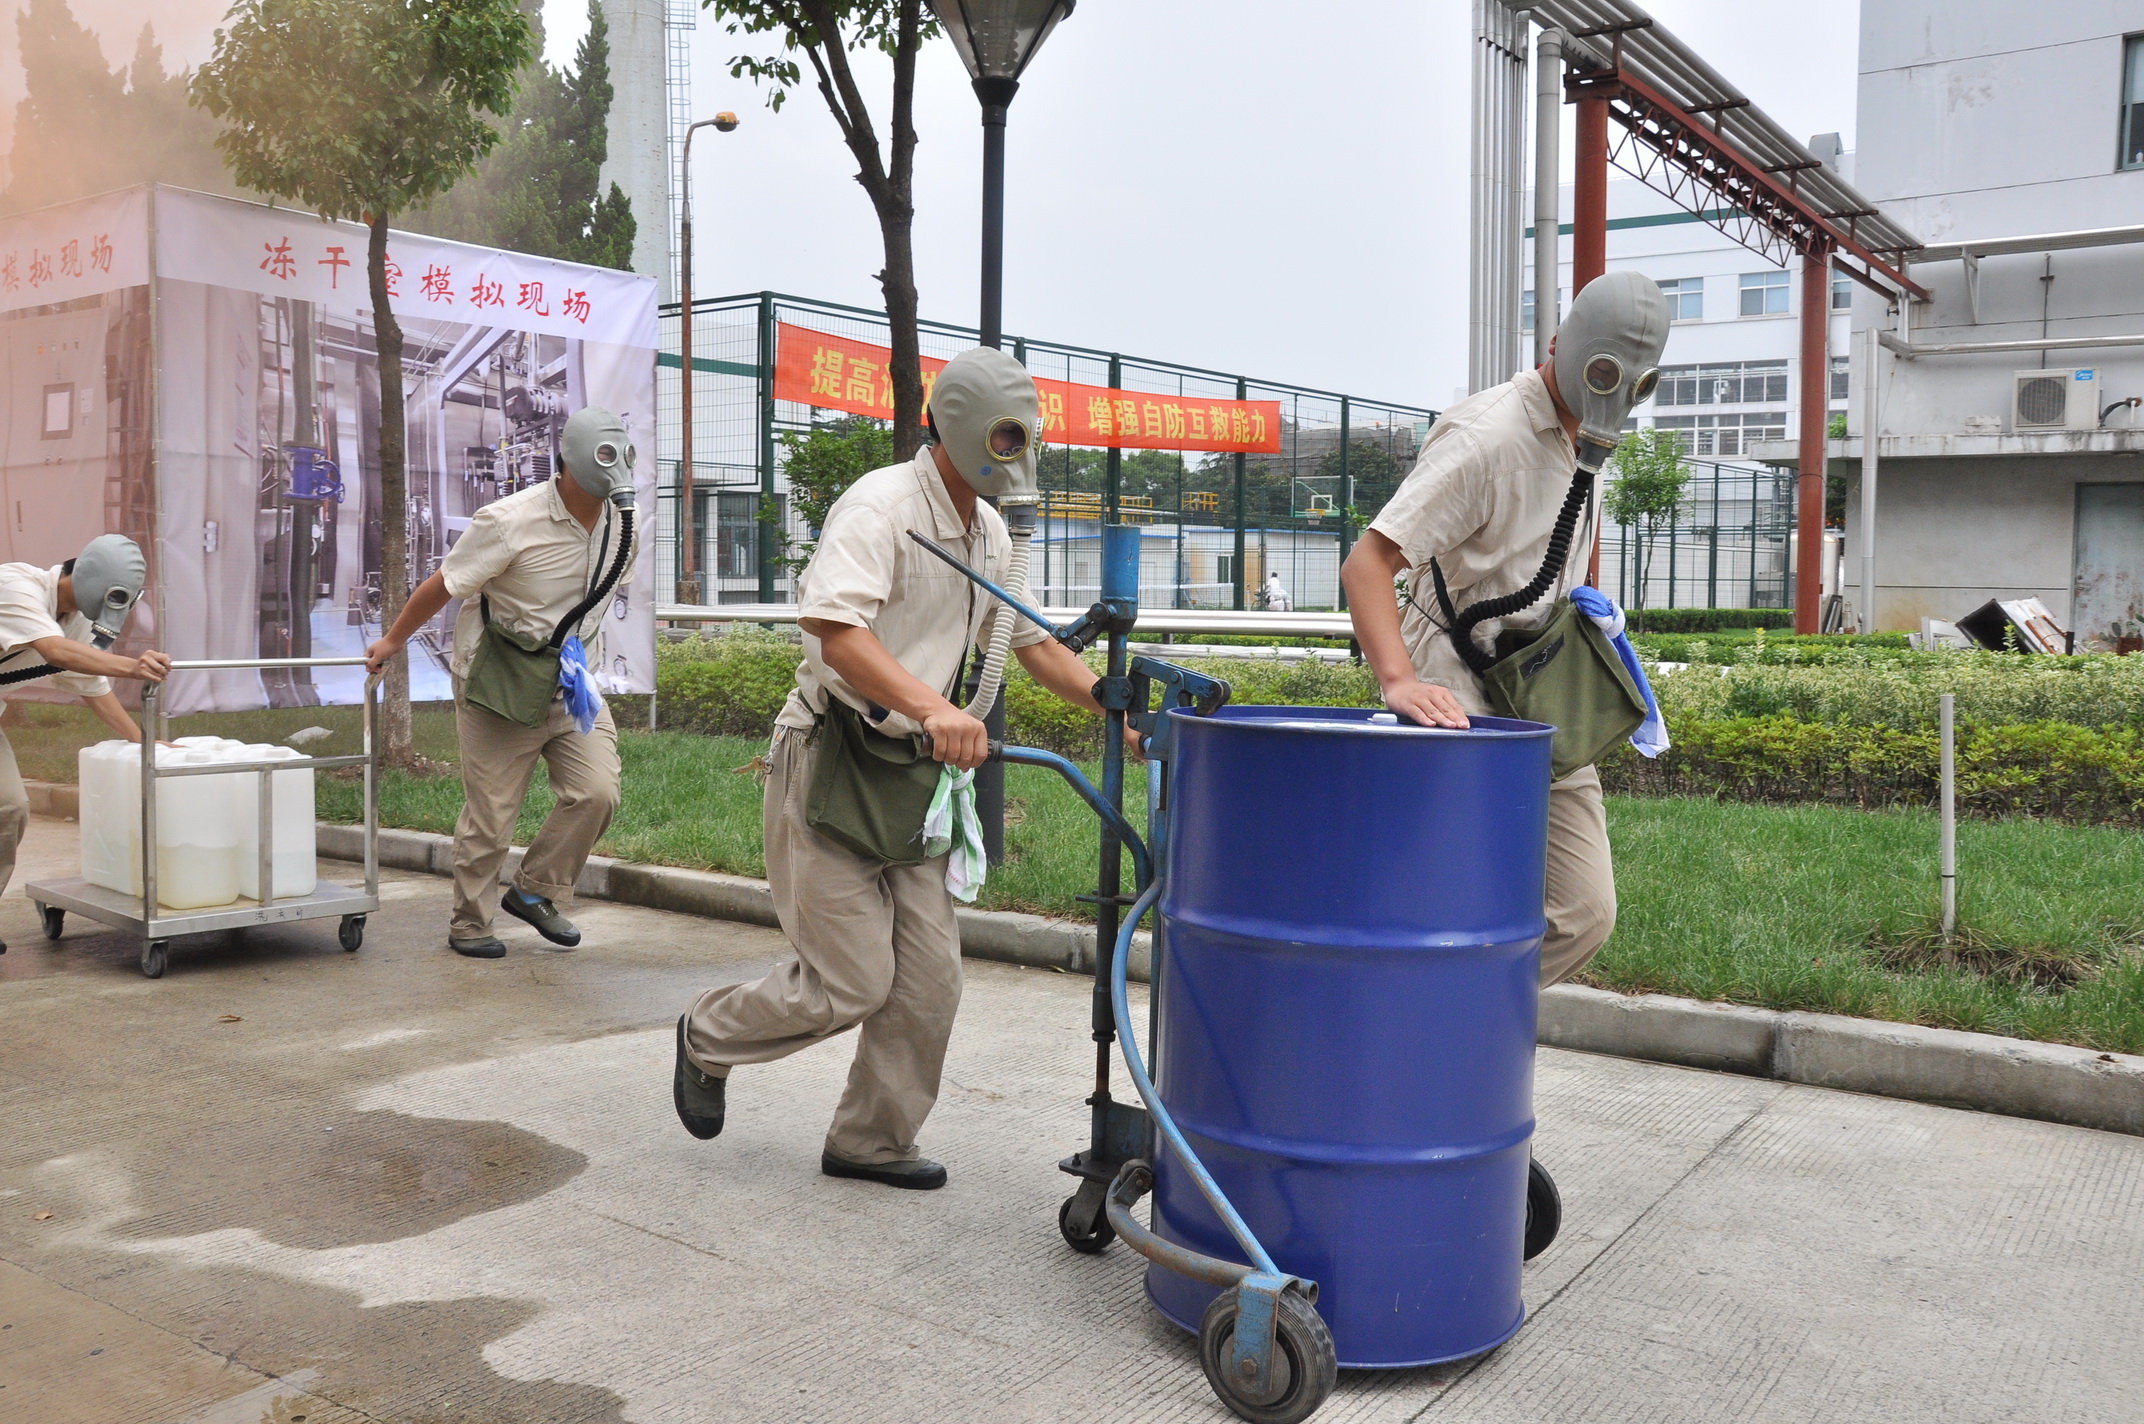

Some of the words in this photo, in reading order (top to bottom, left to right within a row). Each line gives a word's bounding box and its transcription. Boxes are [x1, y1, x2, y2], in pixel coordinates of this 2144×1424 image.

[2, 233, 113, 293] 模拟现场
[1087, 396, 1266, 443] 增强自防互救能力
